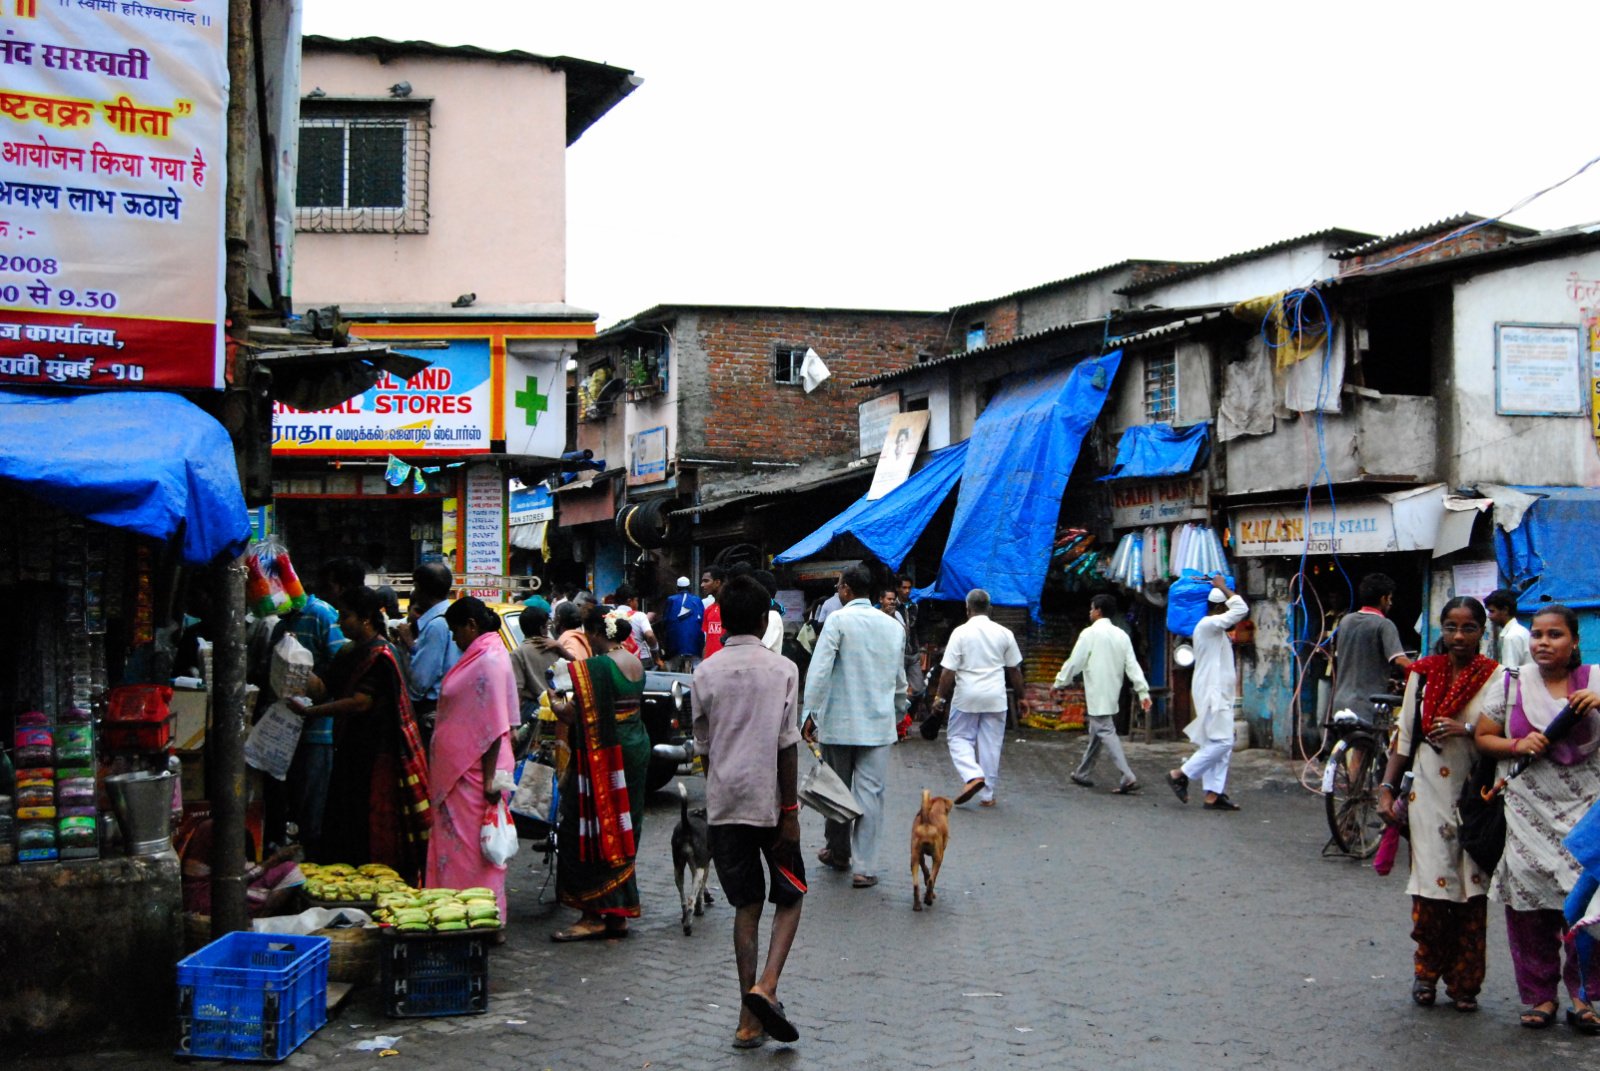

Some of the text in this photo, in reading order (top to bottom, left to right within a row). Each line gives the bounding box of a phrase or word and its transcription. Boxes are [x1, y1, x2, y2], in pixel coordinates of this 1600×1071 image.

[120, 1, 197, 26] हरिश्वरानंद
[41, 44, 151, 80] सरस्वती
[2, 134, 207, 187] आयोजन किया गया है
[66, 186, 117, 214] लाभ
[121, 186, 183, 220] ऊठाये
[26, 278, 52, 305] से
[58, 289, 117, 309] 9.30
[25, 322, 125, 349] कार्यालय,
[45, 353, 95, 382] मुंबई
[406, 367, 452, 390] AND
[375, 394, 473, 414] STORES
[522, 512, 544, 522] STORES
[1339, 518, 1377, 533] STALL
